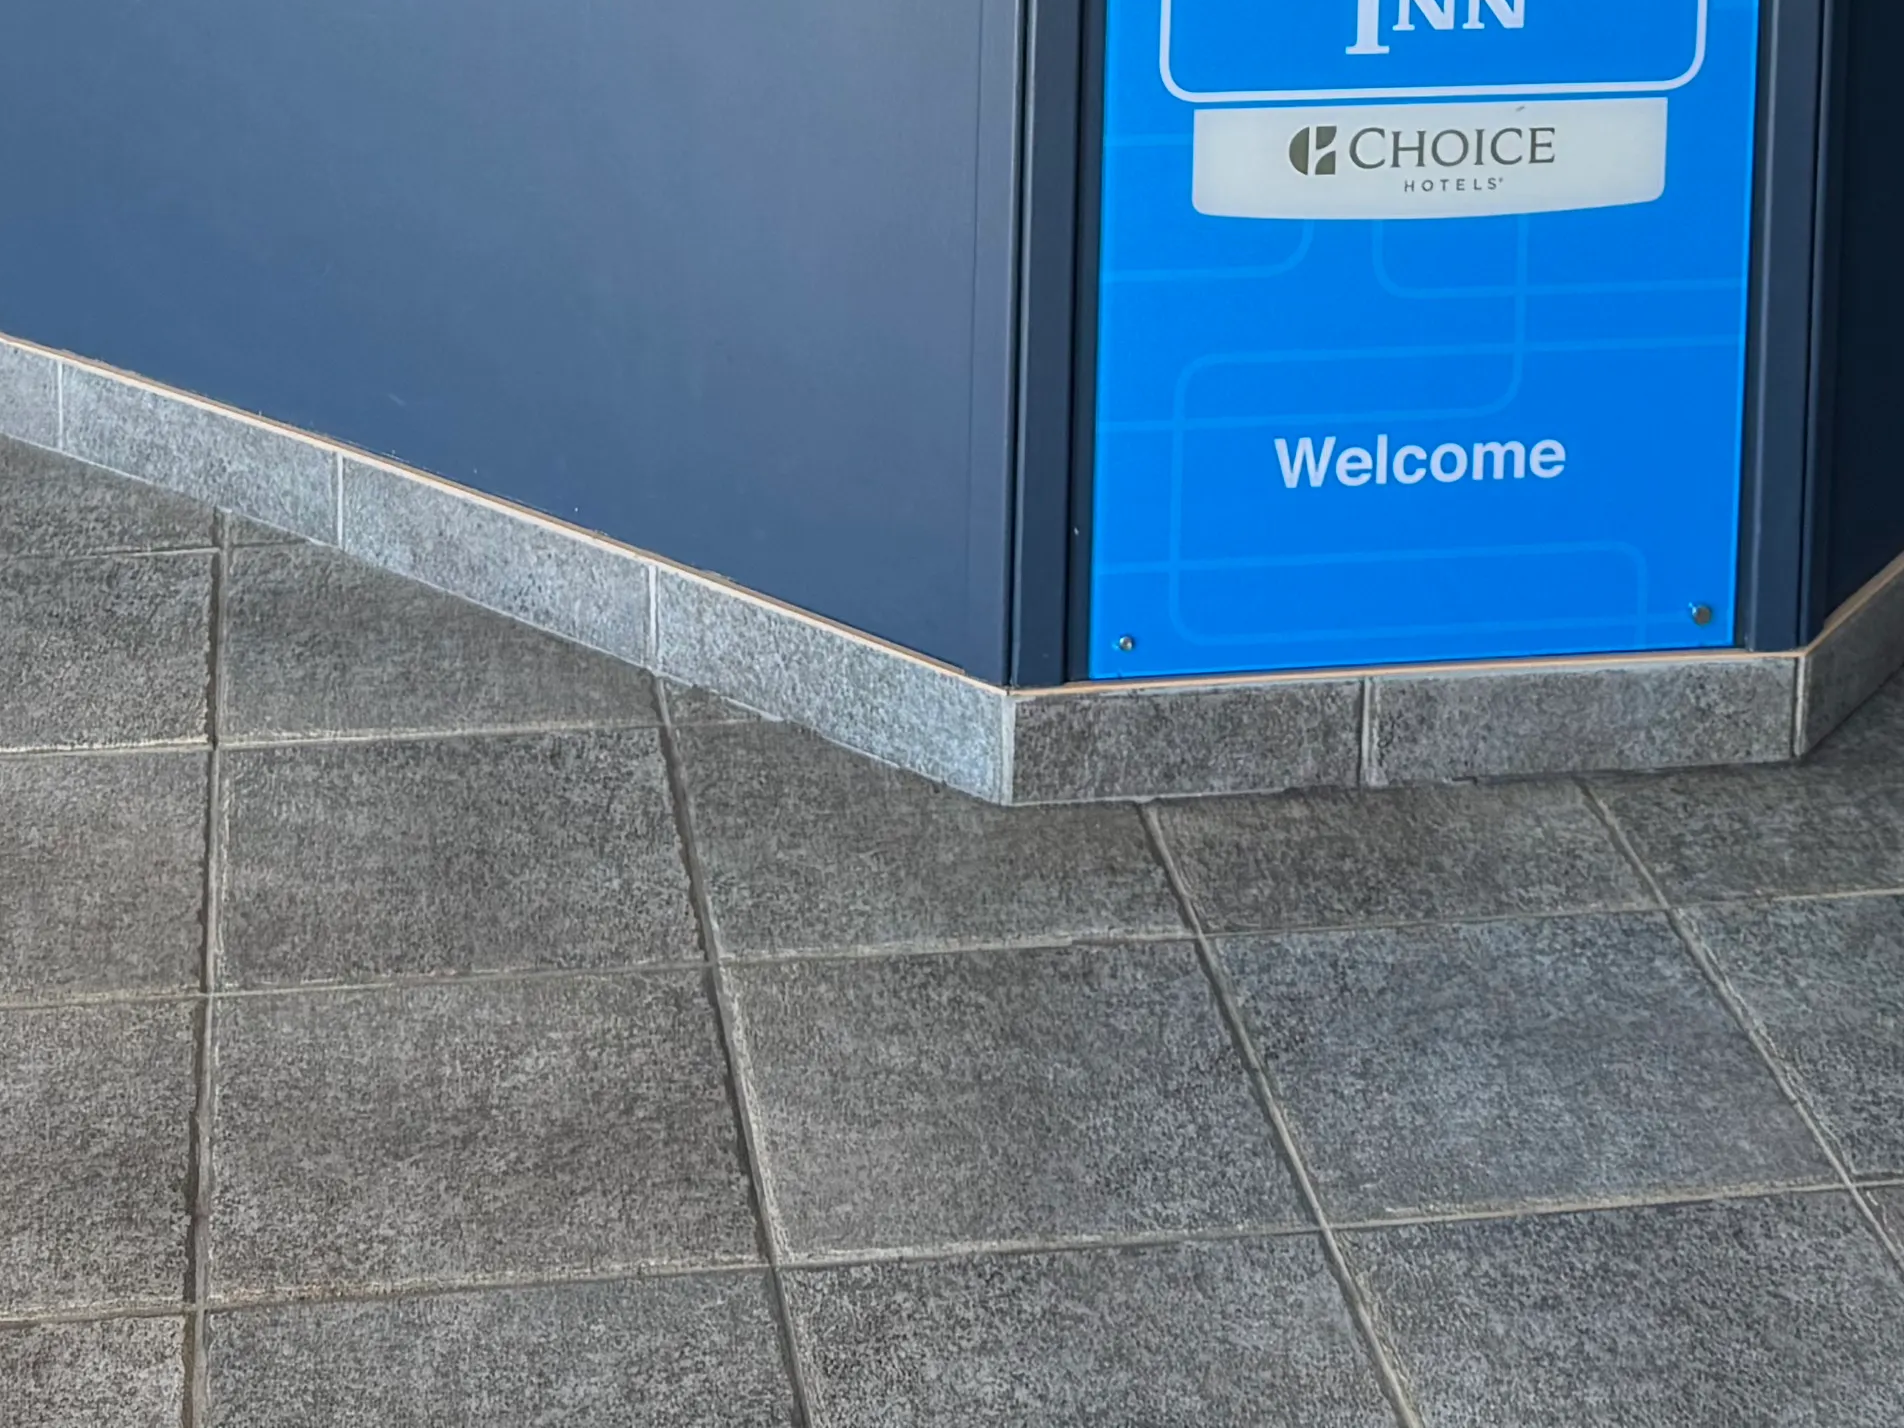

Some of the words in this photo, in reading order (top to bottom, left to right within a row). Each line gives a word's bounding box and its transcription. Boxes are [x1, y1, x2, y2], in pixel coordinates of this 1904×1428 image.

[1348, 126, 1556, 171] CHOICE
[1403, 178, 1498, 193] HOTELS
[1275, 436, 1567, 489] Welcome
